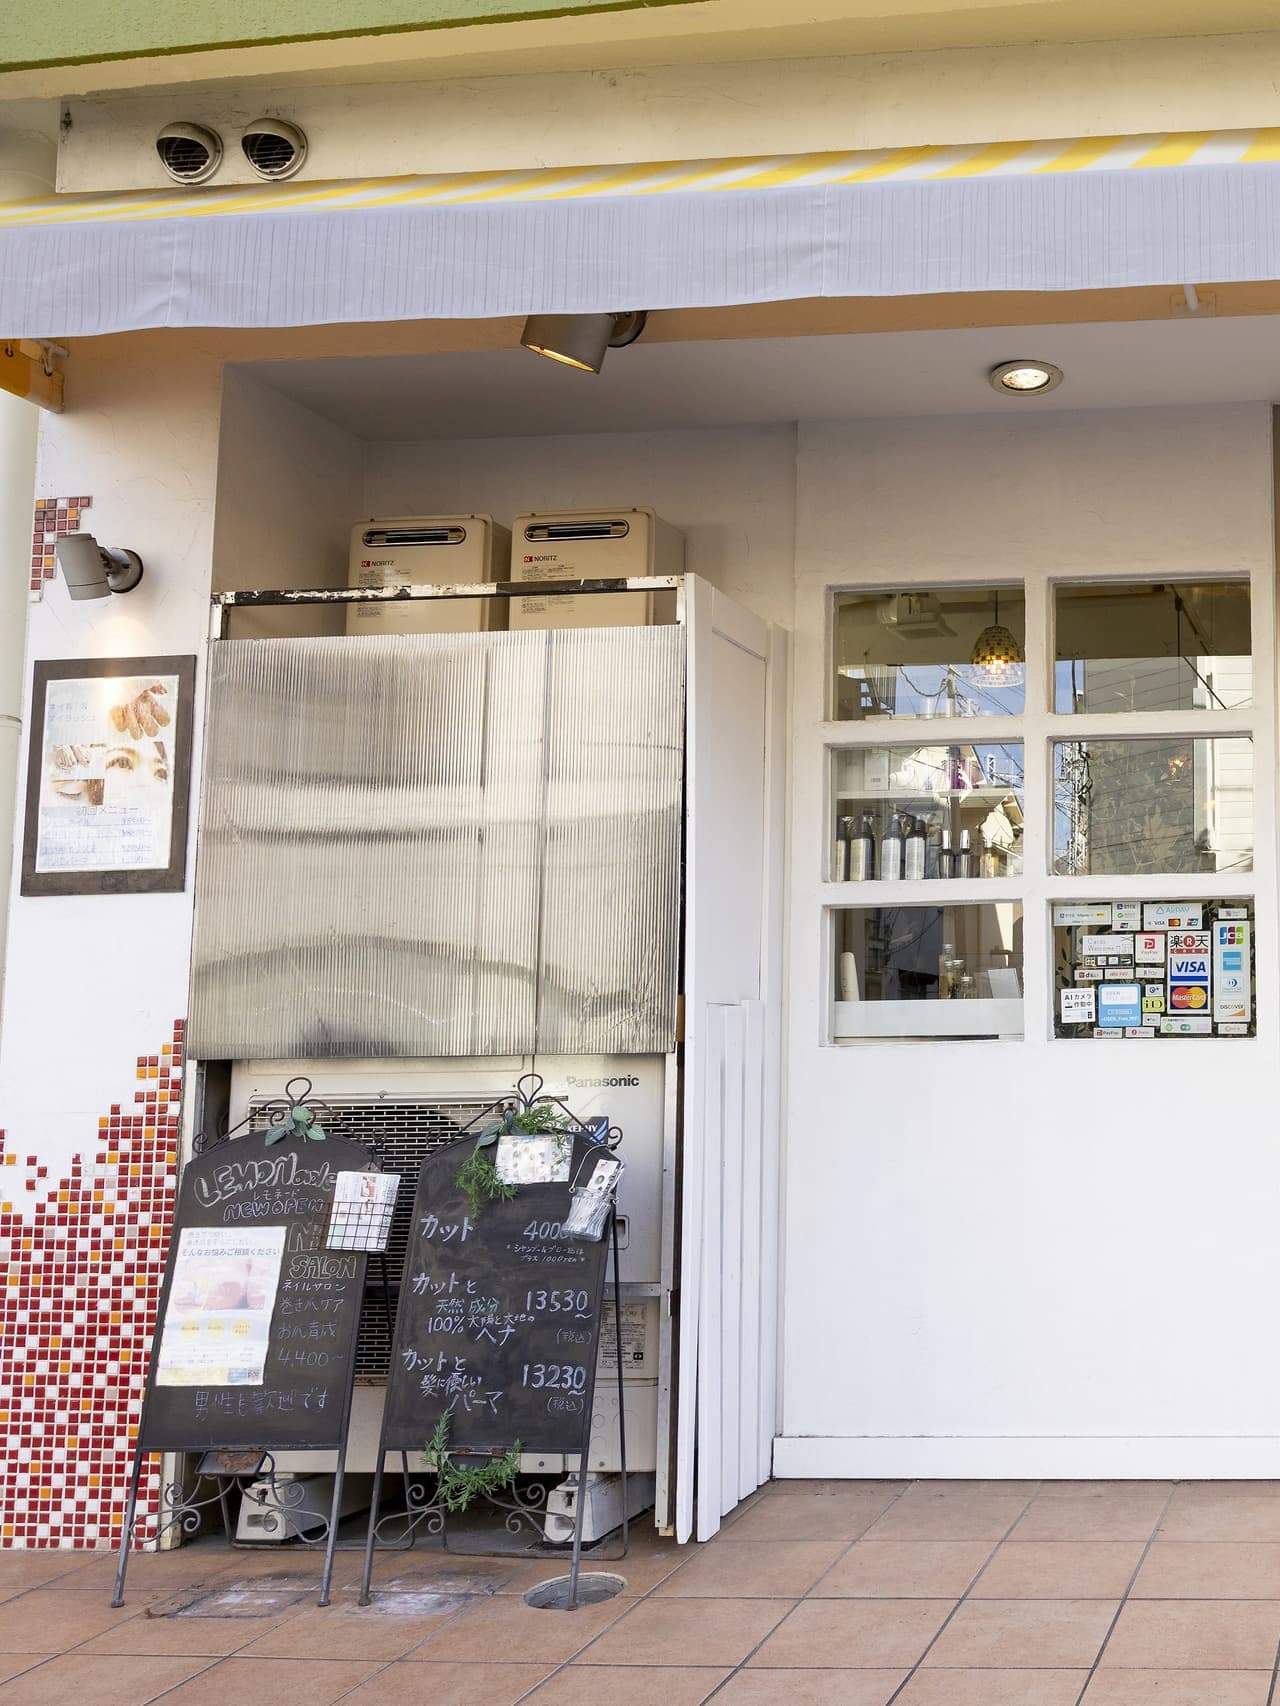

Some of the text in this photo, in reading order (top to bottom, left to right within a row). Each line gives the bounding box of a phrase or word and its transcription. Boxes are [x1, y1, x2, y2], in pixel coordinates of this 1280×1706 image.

[1176, 961, 1206, 973] VISA
[566, 1074, 640, 1088] Panasonic
[253, 1189, 301, 1200] レモネード
[224, 1198, 324, 1221] NEW OPEN
[420, 1214, 474, 1242] カット
[289, 1255, 357, 1280] SALON
[282, 1280, 346, 1292] ネイルサロン
[475, 1325, 516, 1346] ヘナ
[420, 1372, 483, 1397] 髪に優しい
[448, 1389, 504, 1415] パーマ
